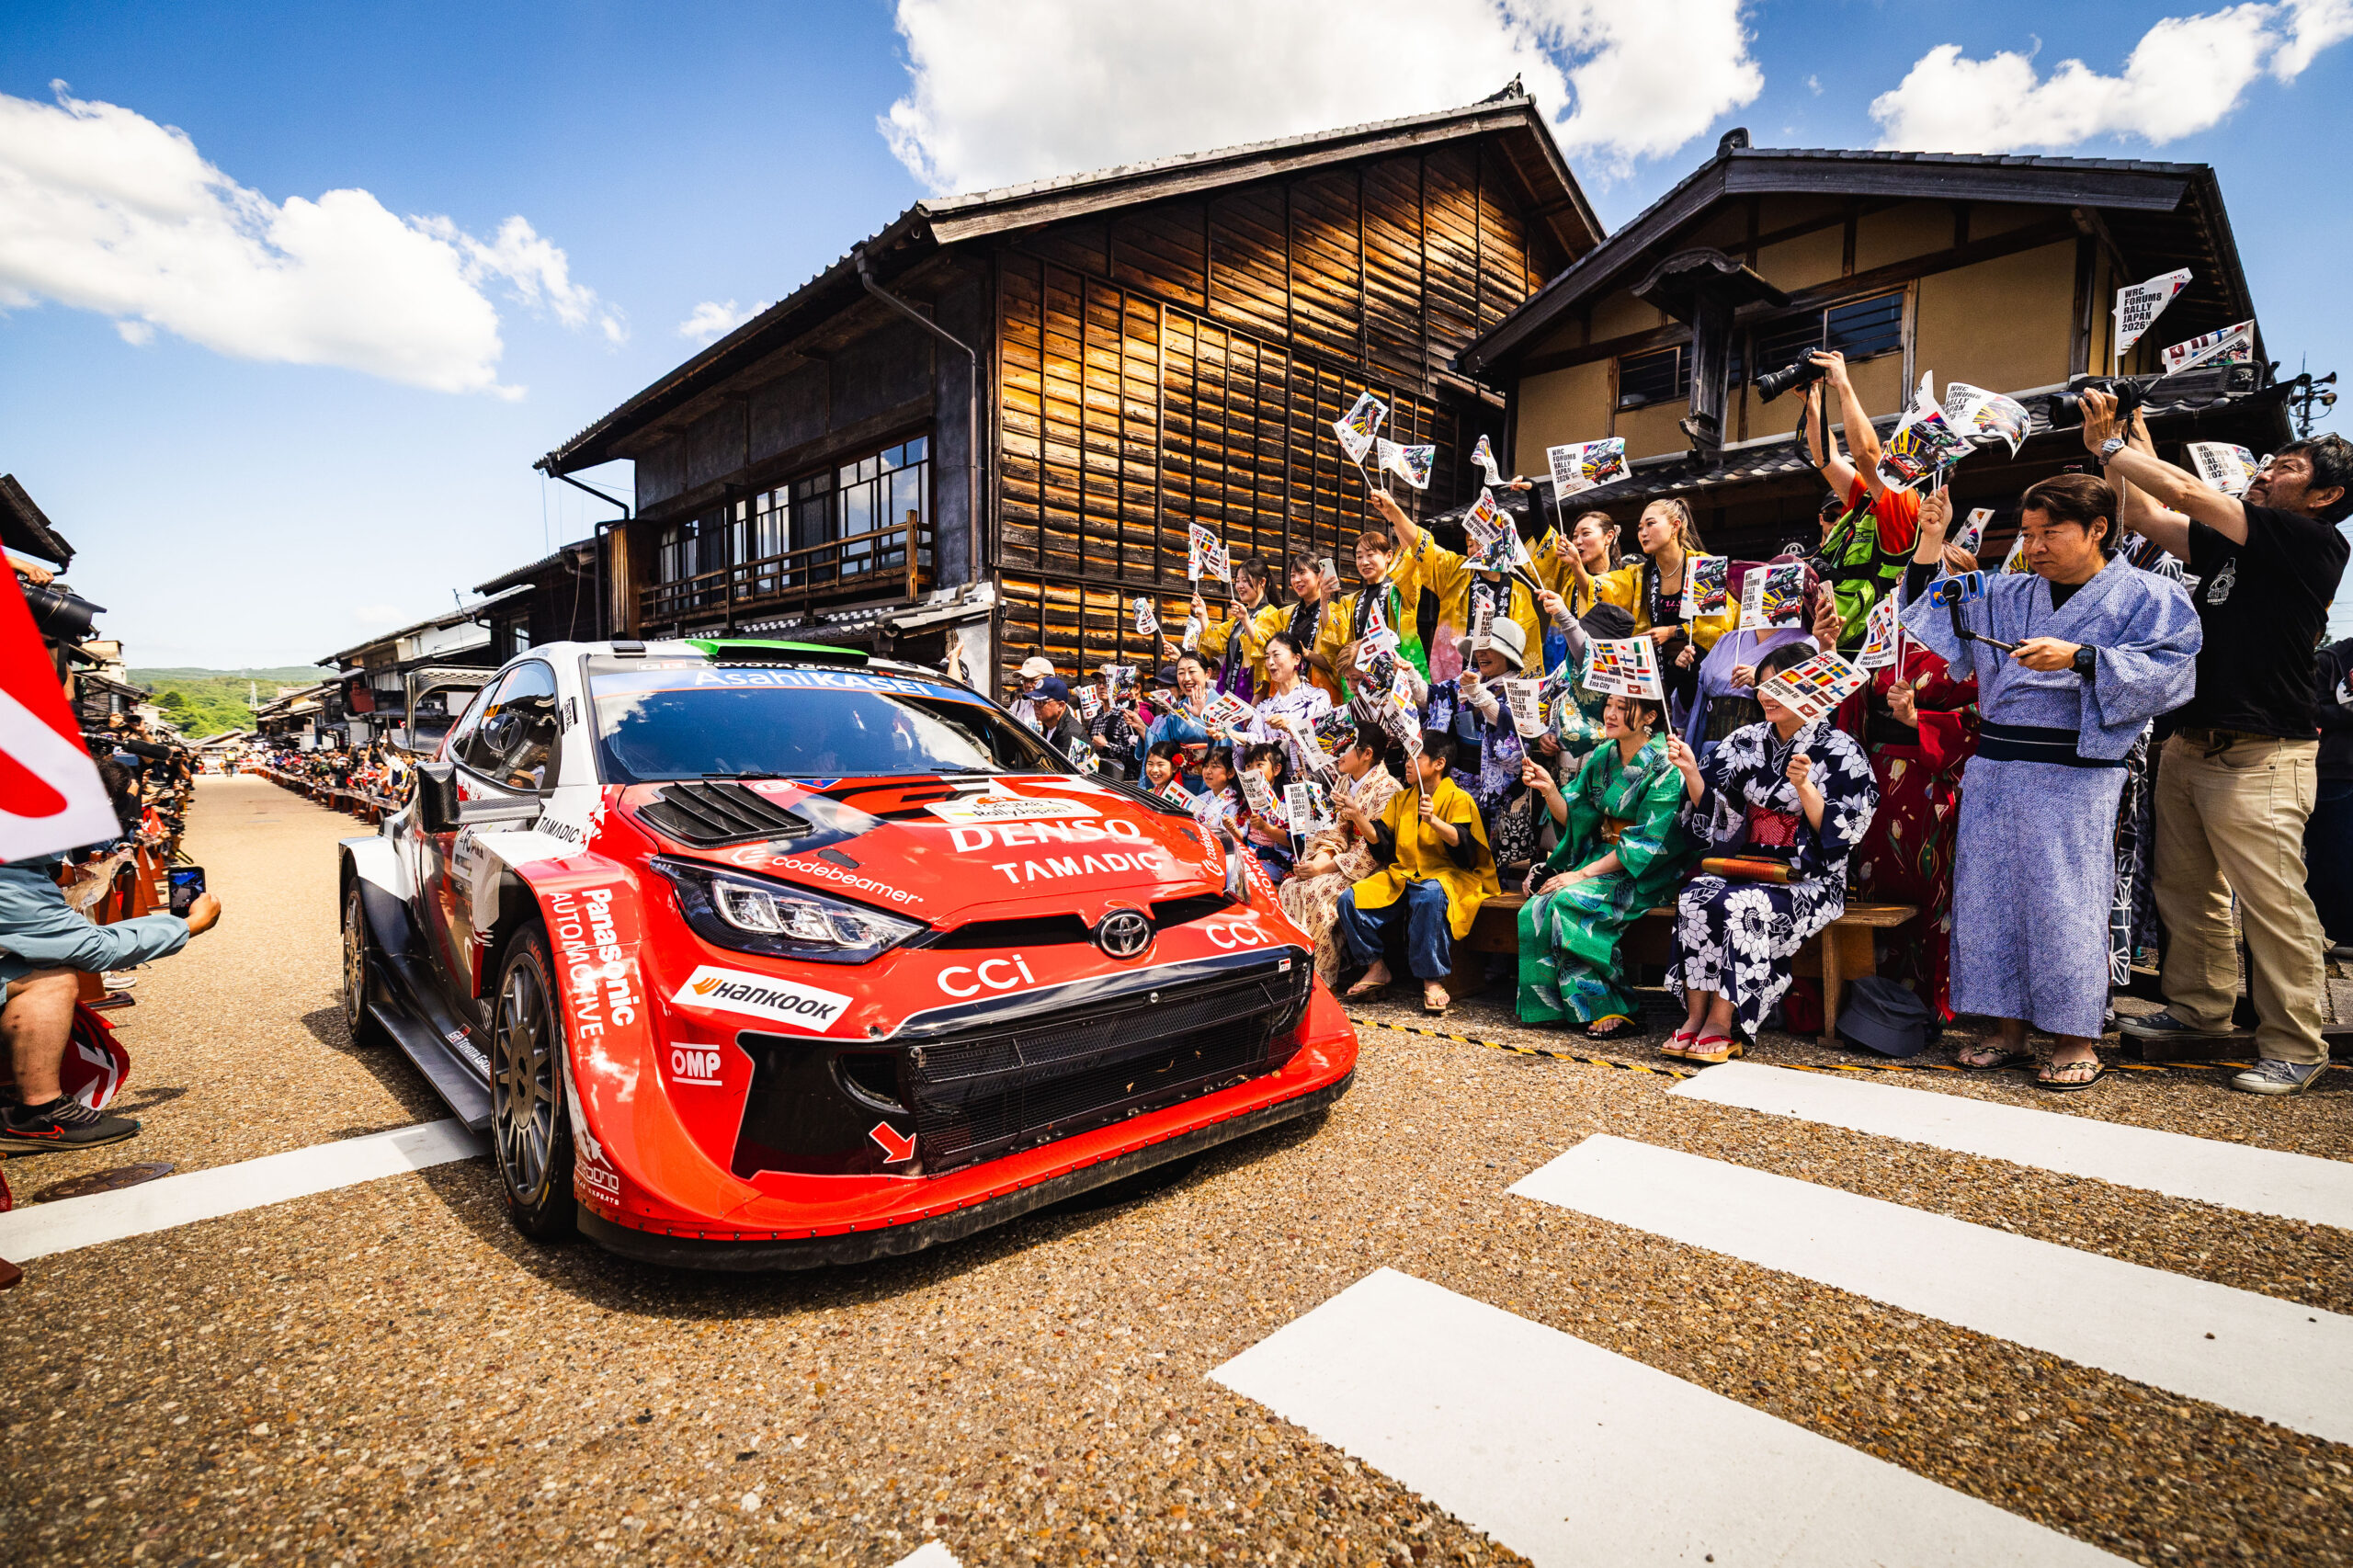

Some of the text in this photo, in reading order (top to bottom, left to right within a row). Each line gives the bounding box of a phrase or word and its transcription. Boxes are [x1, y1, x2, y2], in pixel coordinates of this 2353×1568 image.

[2124, 292, 2163, 306] FORUM8
[2125, 288, 2144, 298] WRC
[2123, 302, 2152, 315] RALLY
[2122, 312, 2152, 324] JAPAN
[2121, 322, 2146, 332] 2026
[1552, 453, 1576, 462] FORUM8
[1553, 460, 1571, 469] RALLY
[1555, 467, 1572, 476] JAPAN
[2206, 470, 2228, 479] 2026
[1556, 474, 1570, 483] 2026
[1469, 515, 1490, 536] Welcome
[1472, 526, 1483, 537] City
[1862, 653, 1888, 661] Welcome
[695, 661, 792, 669] TOYOTA
[1591, 673, 1616, 683] Welcome
[1768, 678, 1795, 695] Welcome
[1508, 696, 1526, 704] RALLY
[563, 699, 574, 733] CENTRAL
[536, 816, 580, 843] TAMADIC
[947, 818, 1141, 853] DENSO
[992, 852, 1164, 884] TAMADIC
[771, 853, 920, 905] codebeamer
[581, 888, 641, 1028] Panasonic
[549, 892, 605, 1040] AUTOMOTIVE
[457, 1036, 481, 1060] TOYOTA
[671, 1049, 722, 1079] OMP
